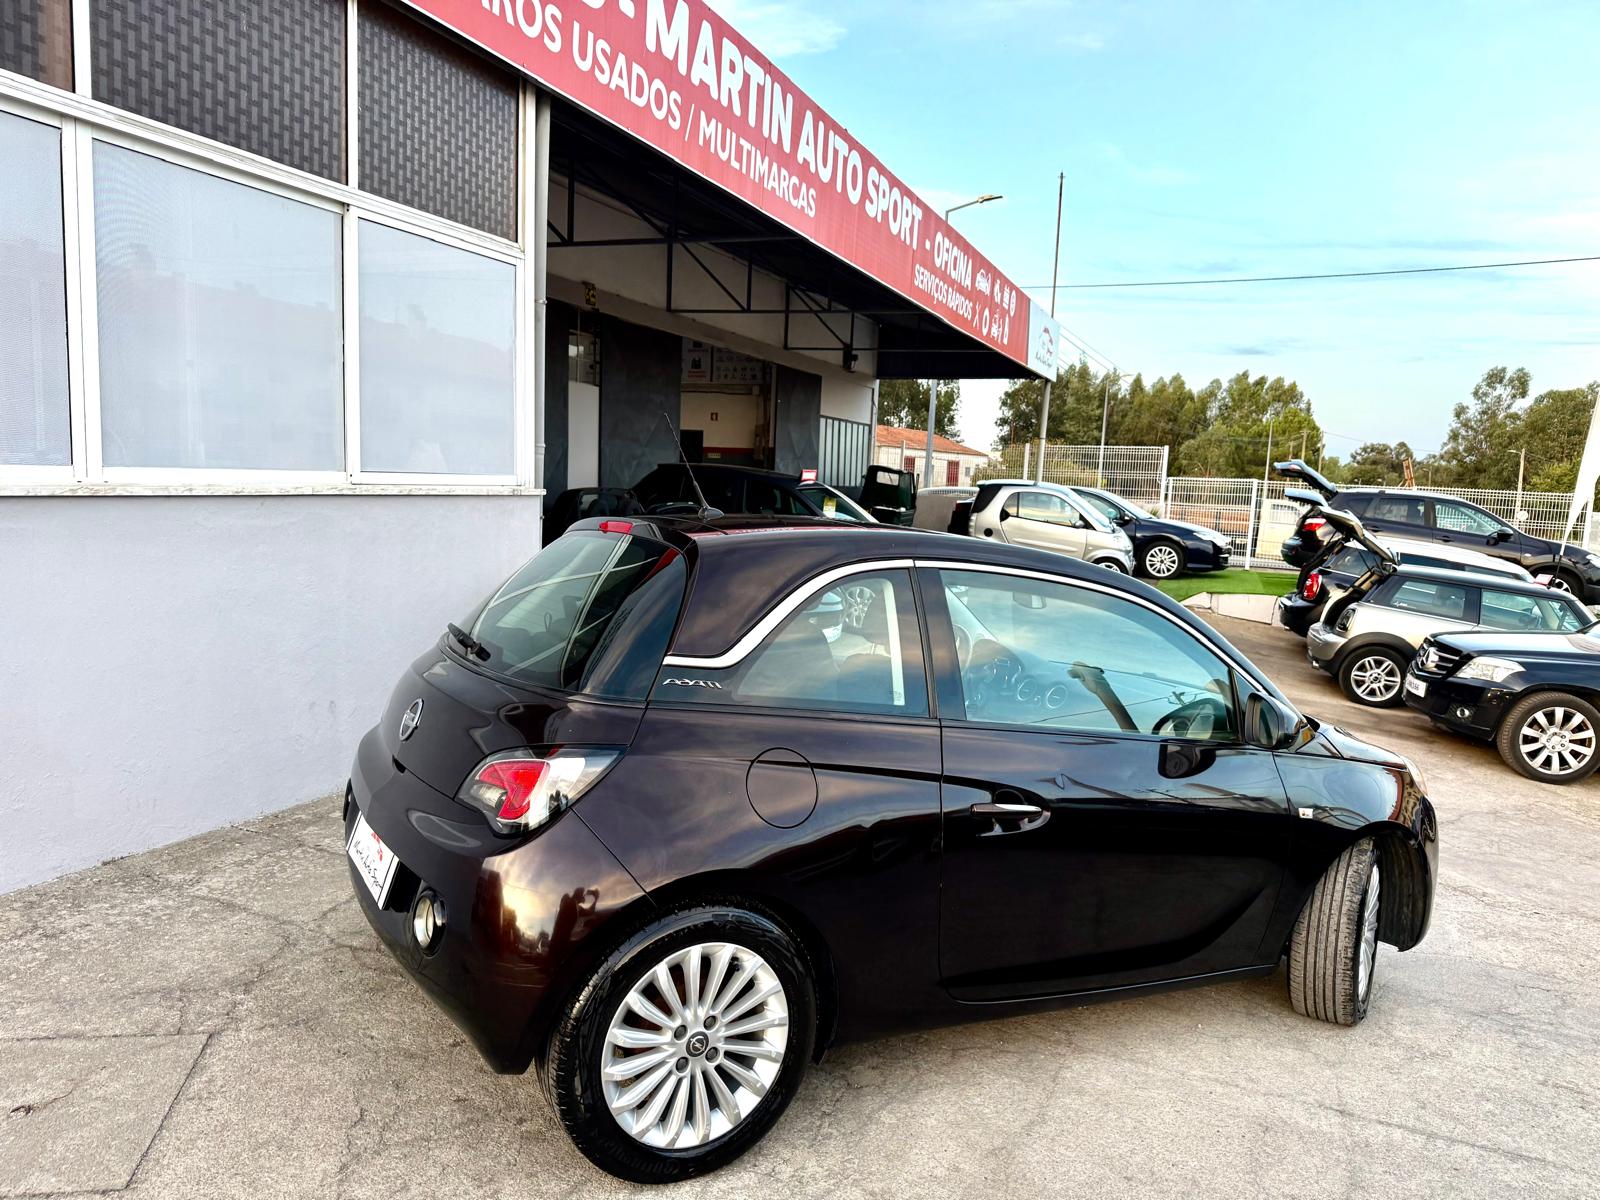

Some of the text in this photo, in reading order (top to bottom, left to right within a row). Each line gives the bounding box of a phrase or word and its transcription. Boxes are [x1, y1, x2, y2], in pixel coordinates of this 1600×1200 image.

[572, 20, 682, 130] USADOS
[699, 110, 816, 218] MULTIMARCAS
[645, 0, 793, 154] MARTIN
[797, 109, 863, 205] AUTO
[865, 166, 923, 250] SPORT
[934, 231, 973, 291] OFICINA
[914, 263, 948, 304] SERVIÇOS
